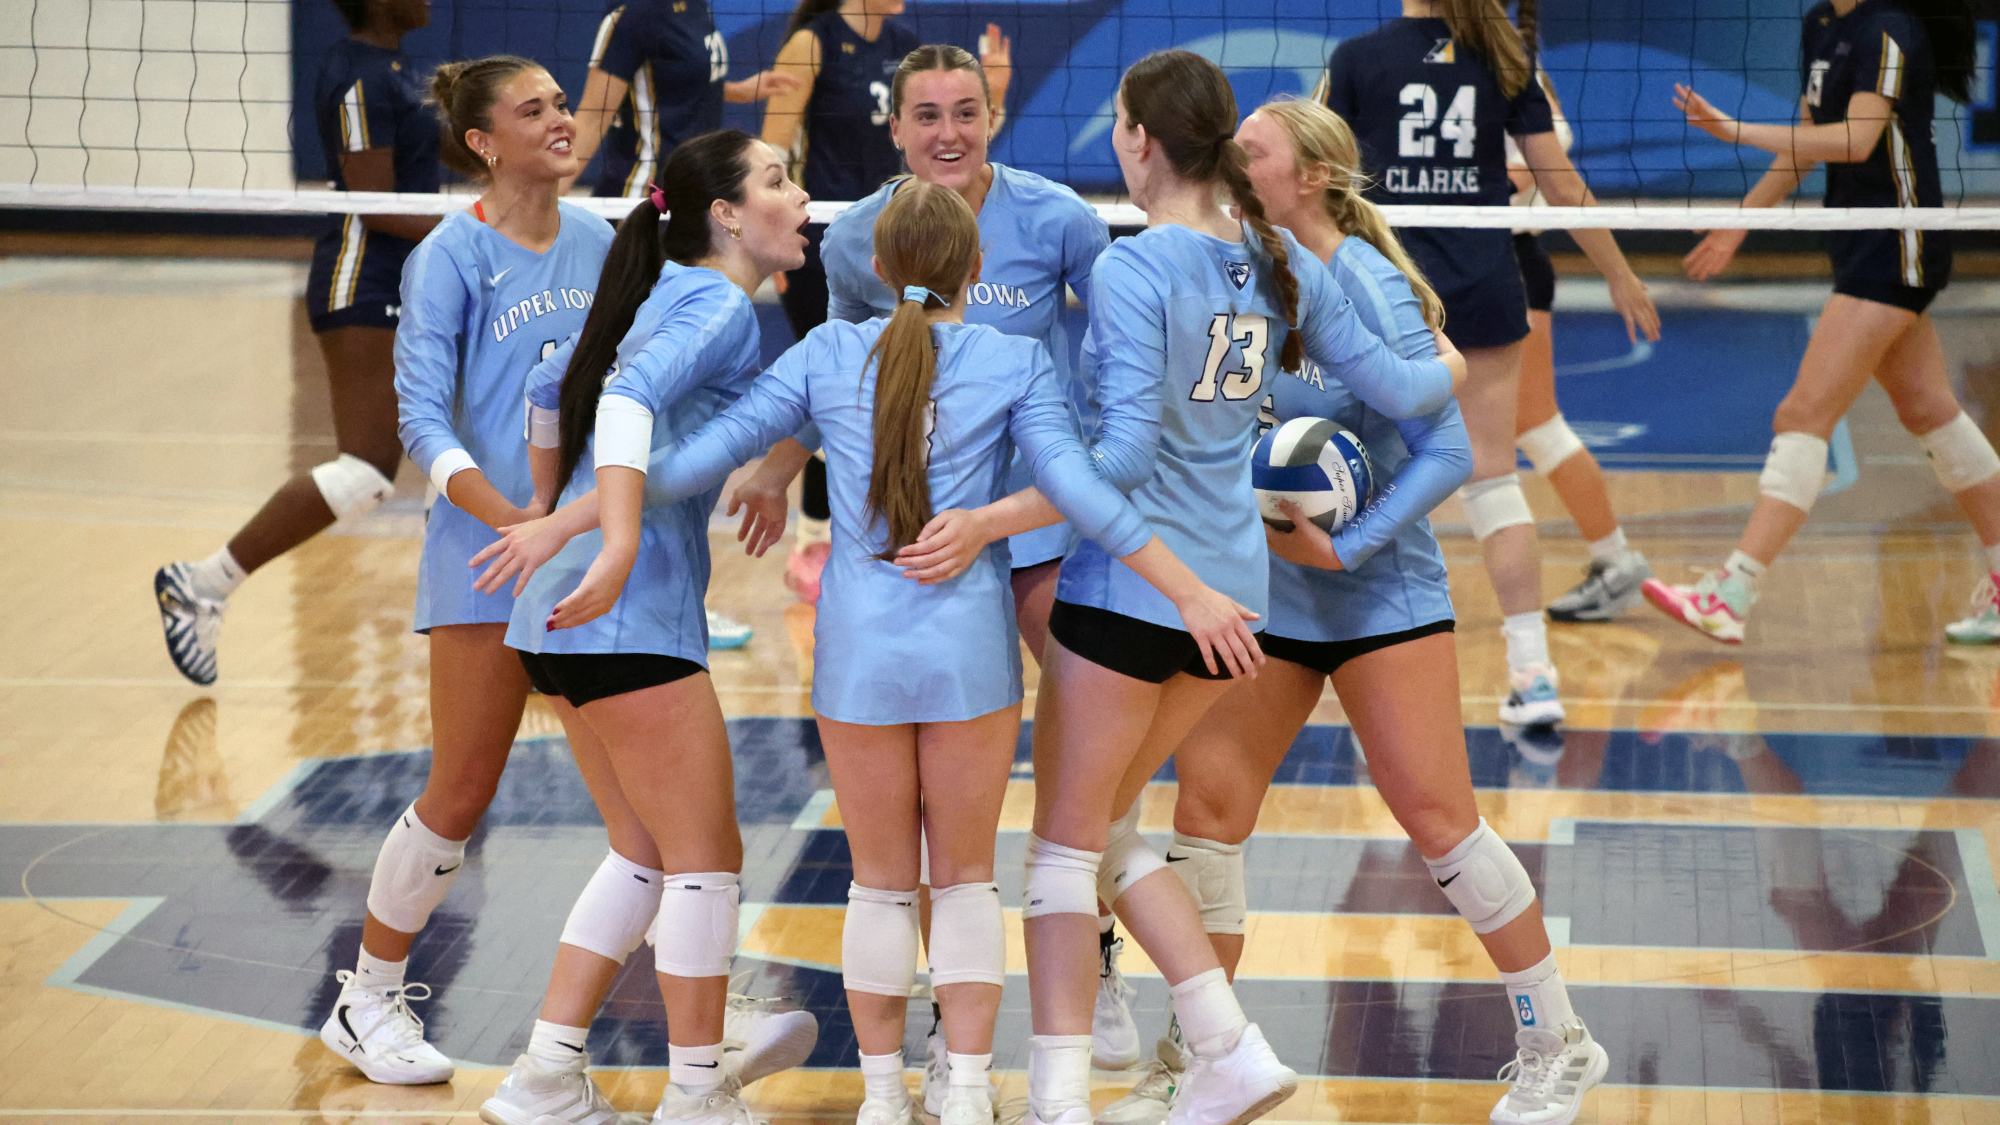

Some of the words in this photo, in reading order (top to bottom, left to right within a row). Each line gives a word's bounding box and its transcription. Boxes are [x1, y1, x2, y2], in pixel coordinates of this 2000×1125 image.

[1398, 83, 1477, 159] 24
[1385, 165, 1480, 194] CLARKE
[492, 289, 558, 343] UPPER
[966, 281, 1031, 308] IOWA
[1188, 312, 1269, 402] 13
[1292, 358, 1326, 393] WA
[1350, 483, 1397, 529] PEACOCKS
